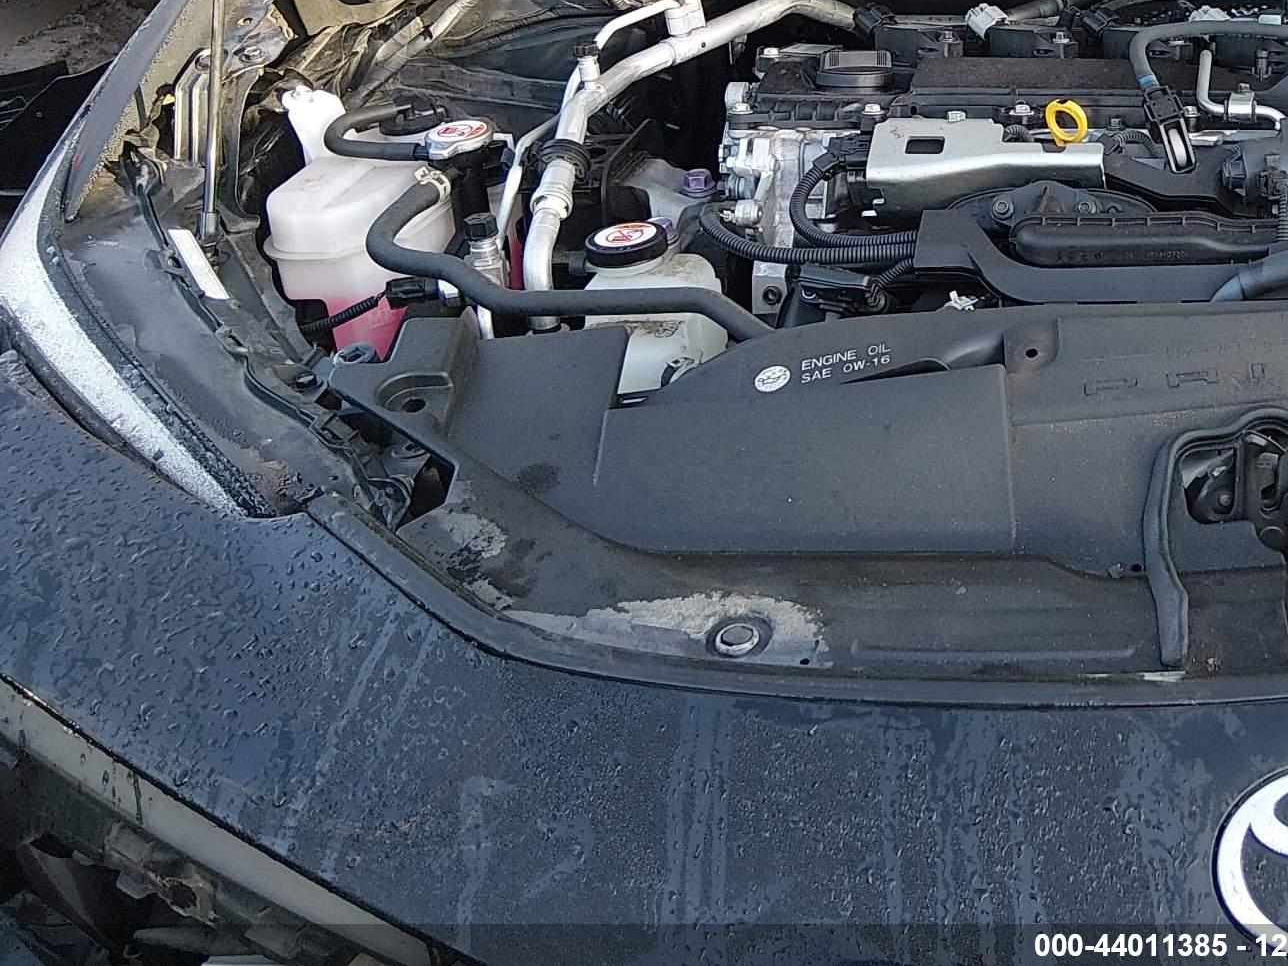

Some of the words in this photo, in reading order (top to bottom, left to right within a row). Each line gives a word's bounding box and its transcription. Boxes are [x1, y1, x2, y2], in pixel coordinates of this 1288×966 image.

[801, 349, 858, 371] ENGINE
[867, 343, 892, 356] OIL
[801, 367, 833, 384] SAE
